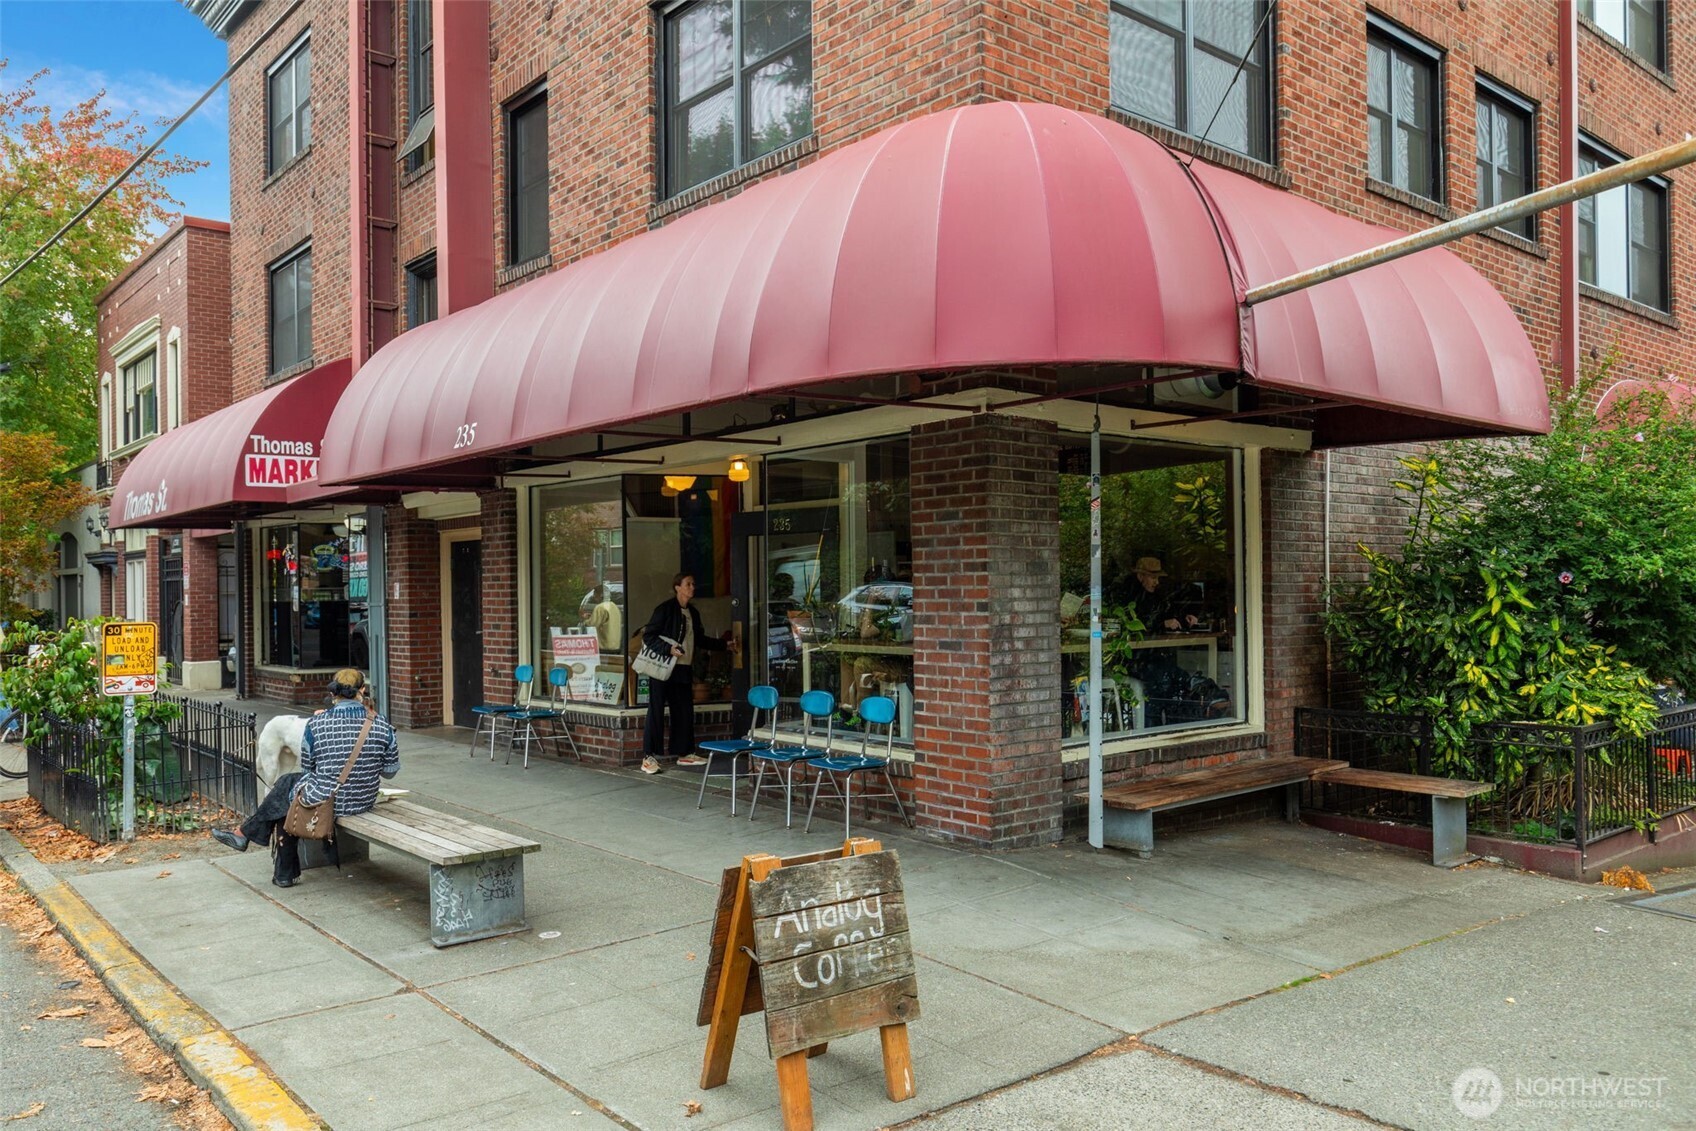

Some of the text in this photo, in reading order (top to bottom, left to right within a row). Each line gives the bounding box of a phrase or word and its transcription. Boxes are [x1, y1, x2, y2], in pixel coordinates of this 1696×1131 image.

[250, 435, 313, 455] Thomas
[453, 422, 478, 449] 235
[249, 457, 320, 484] MARK
[124, 490, 154, 521] Thomas
[773, 518, 791, 531] 235
[108, 627, 120, 635] 30
[773, 880, 885, 938] Analog
